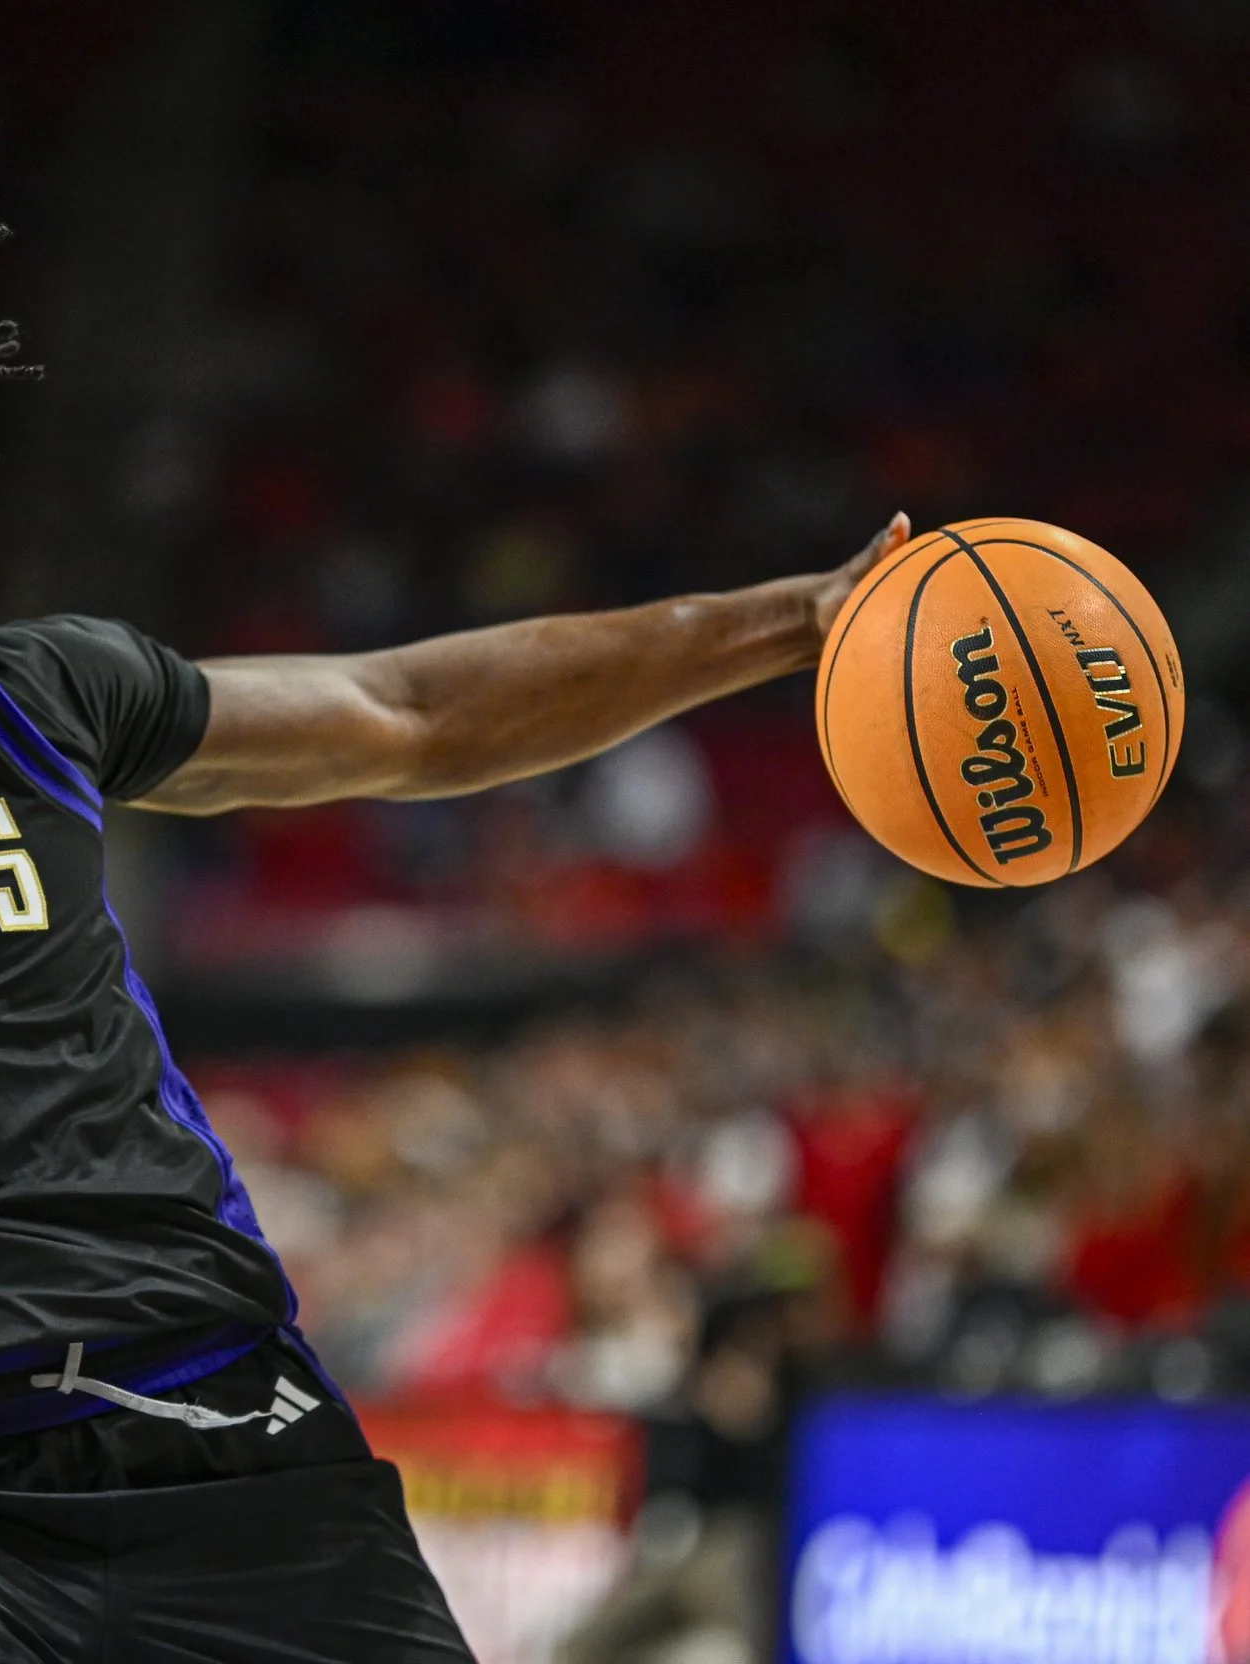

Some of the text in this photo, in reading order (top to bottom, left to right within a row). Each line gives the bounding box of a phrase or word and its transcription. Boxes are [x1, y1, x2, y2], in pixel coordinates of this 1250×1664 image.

[950, 625, 1053, 866] Wilson
[1011, 686, 1049, 798] INDOOR GAME BALL
[1046, 608, 1146, 780] EVO NXT
